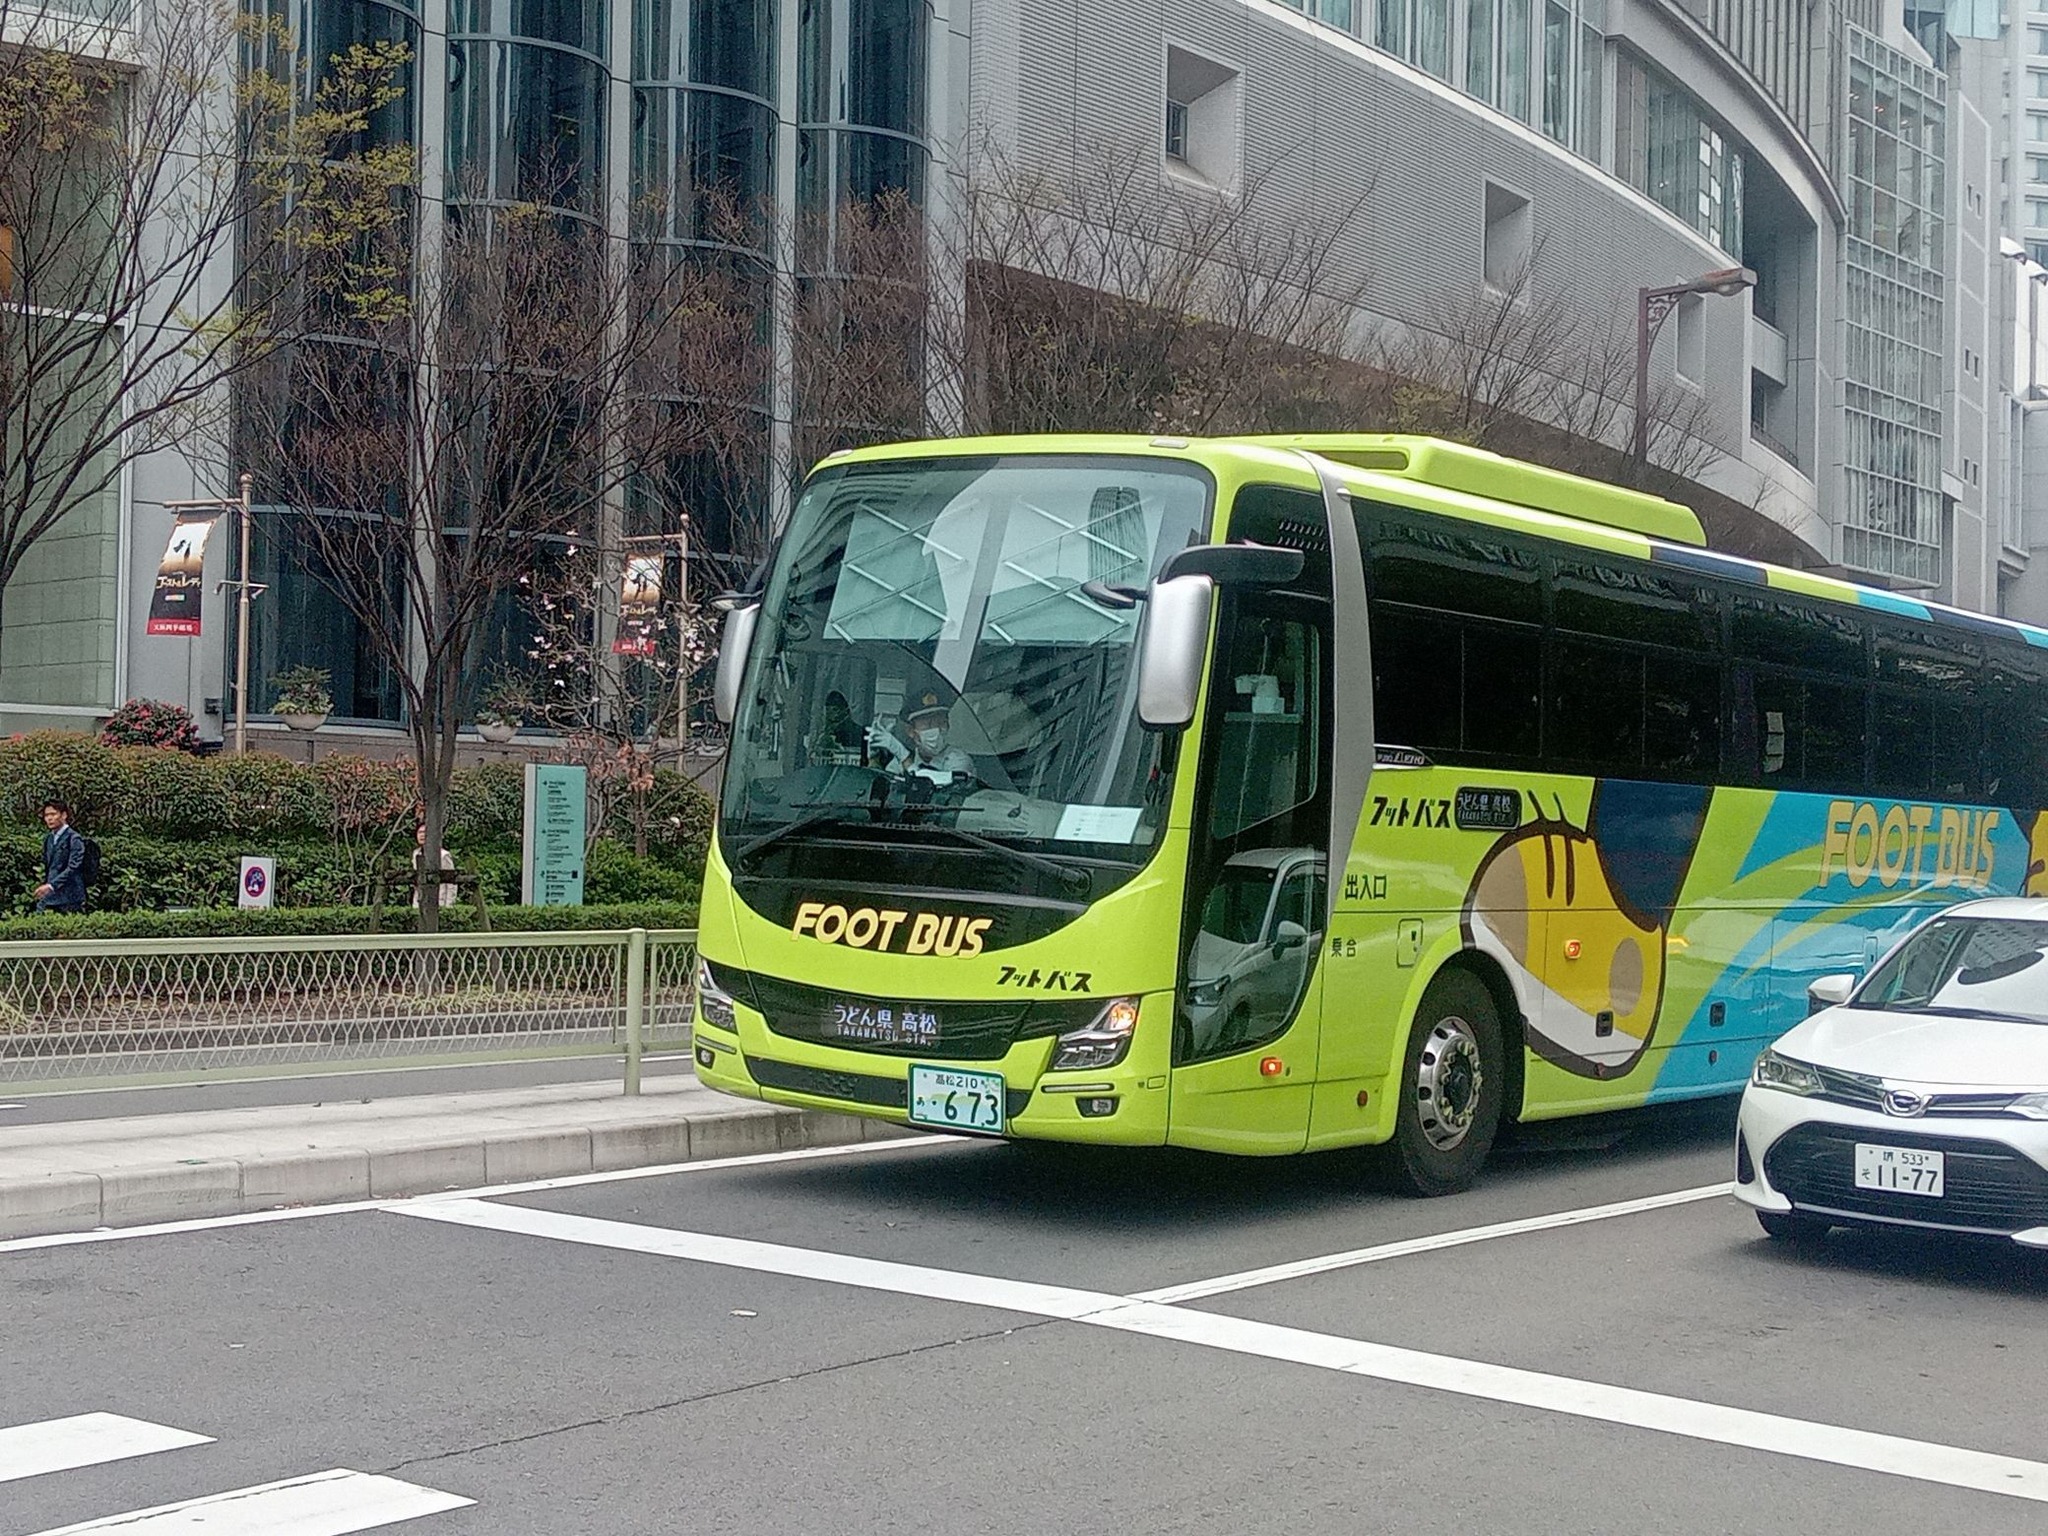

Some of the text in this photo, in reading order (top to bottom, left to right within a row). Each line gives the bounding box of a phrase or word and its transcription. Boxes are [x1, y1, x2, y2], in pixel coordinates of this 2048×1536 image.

[1370, 796, 1451, 828] フットバス
[1818, 800, 1999, 892] FOOT BUS
[1345, 874, 1387, 900] 出入口
[790, 902, 993, 959] FOOT BUS
[996, 966, 1092, 993] フットバス
[834, 1004, 937, 1035] うどん県 高松
[837, 1024, 899, 1042] TAKAMATSU
[1901, 1152, 1924, 1166] 533
[1878, 1165, 1938, 1192] 11-77
